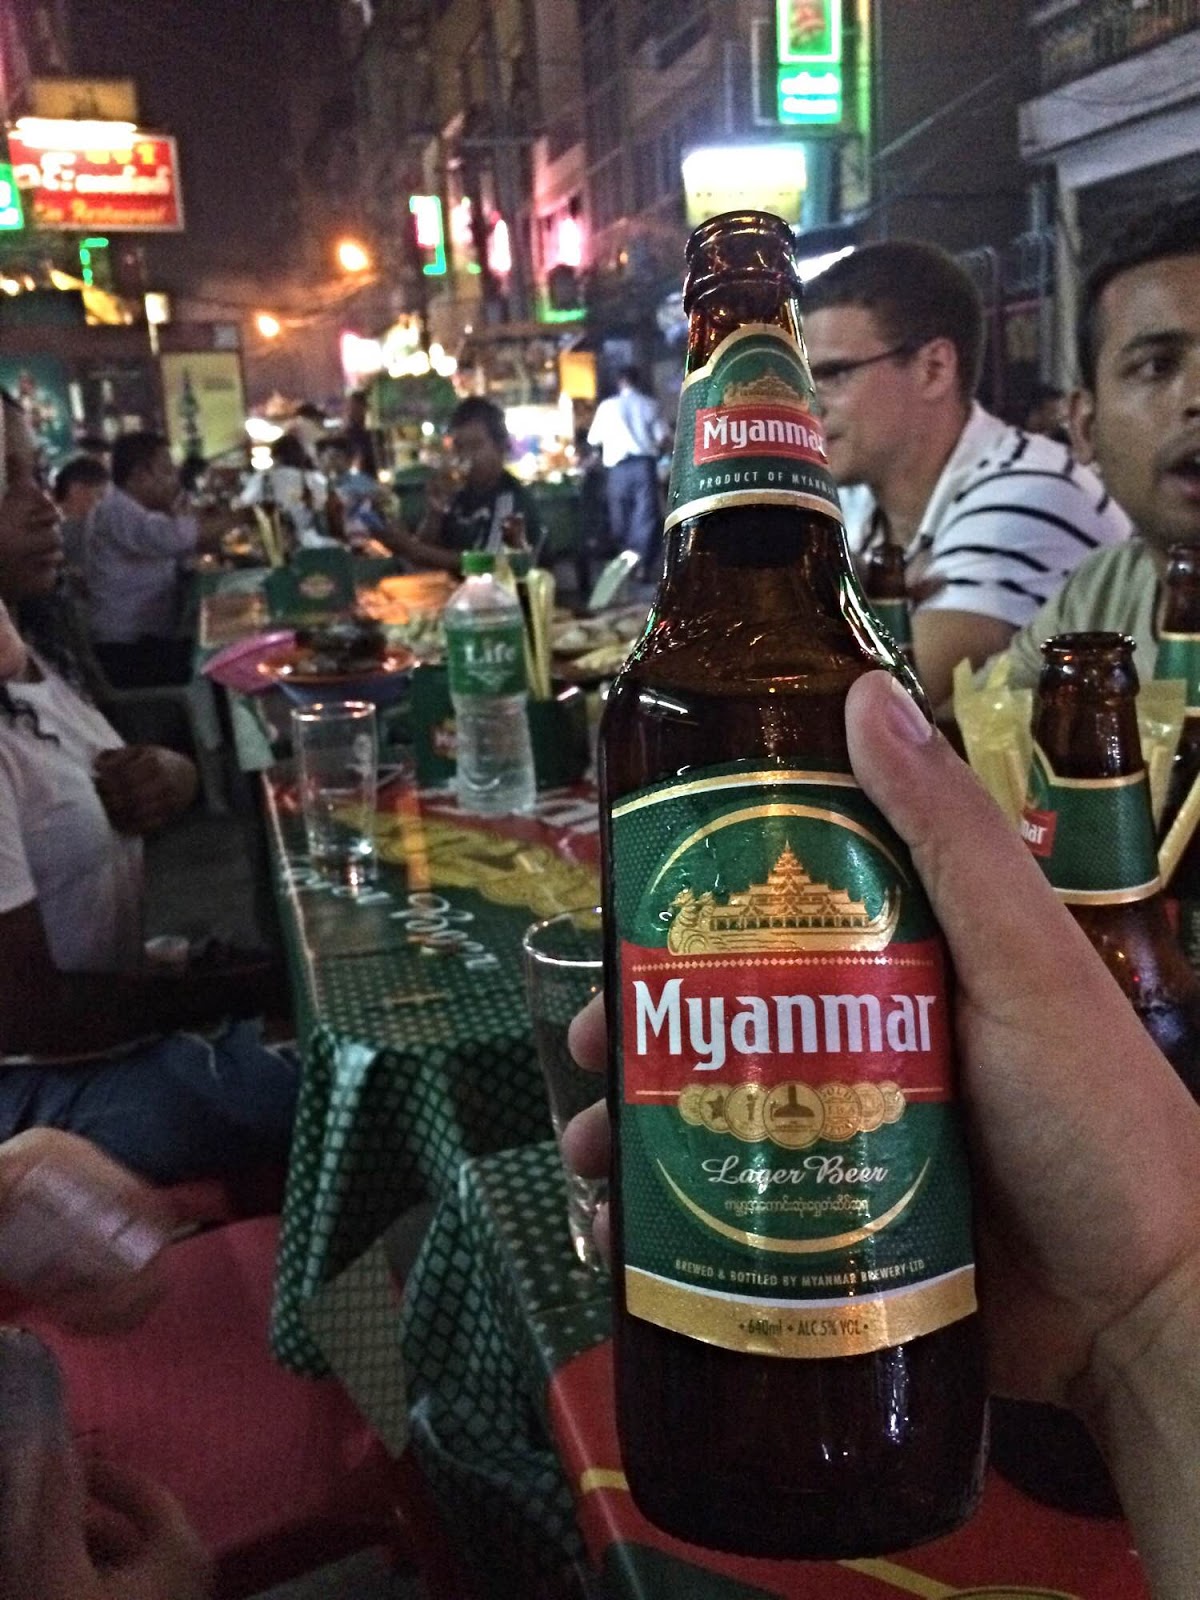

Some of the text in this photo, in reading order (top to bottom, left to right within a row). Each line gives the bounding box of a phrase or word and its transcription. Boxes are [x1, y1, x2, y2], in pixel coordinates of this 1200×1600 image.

[703, 415, 824, 450] Myanmar
[700, 471, 758, 490] PRODUCT
[768, 471, 784, 483] OF
[632, 978, 937, 1071] Myanmar
[702, 1155, 889, 1194] Lager Beer
[675, 1259, 714, 1277] BREWED
[730, 1270, 778, 1286] BOTTLED
[783, 1275, 796, 1286] BY
[801, 1272, 857, 1287] MYANMAR
[860, 1262, 906, 1282] BREWERY
